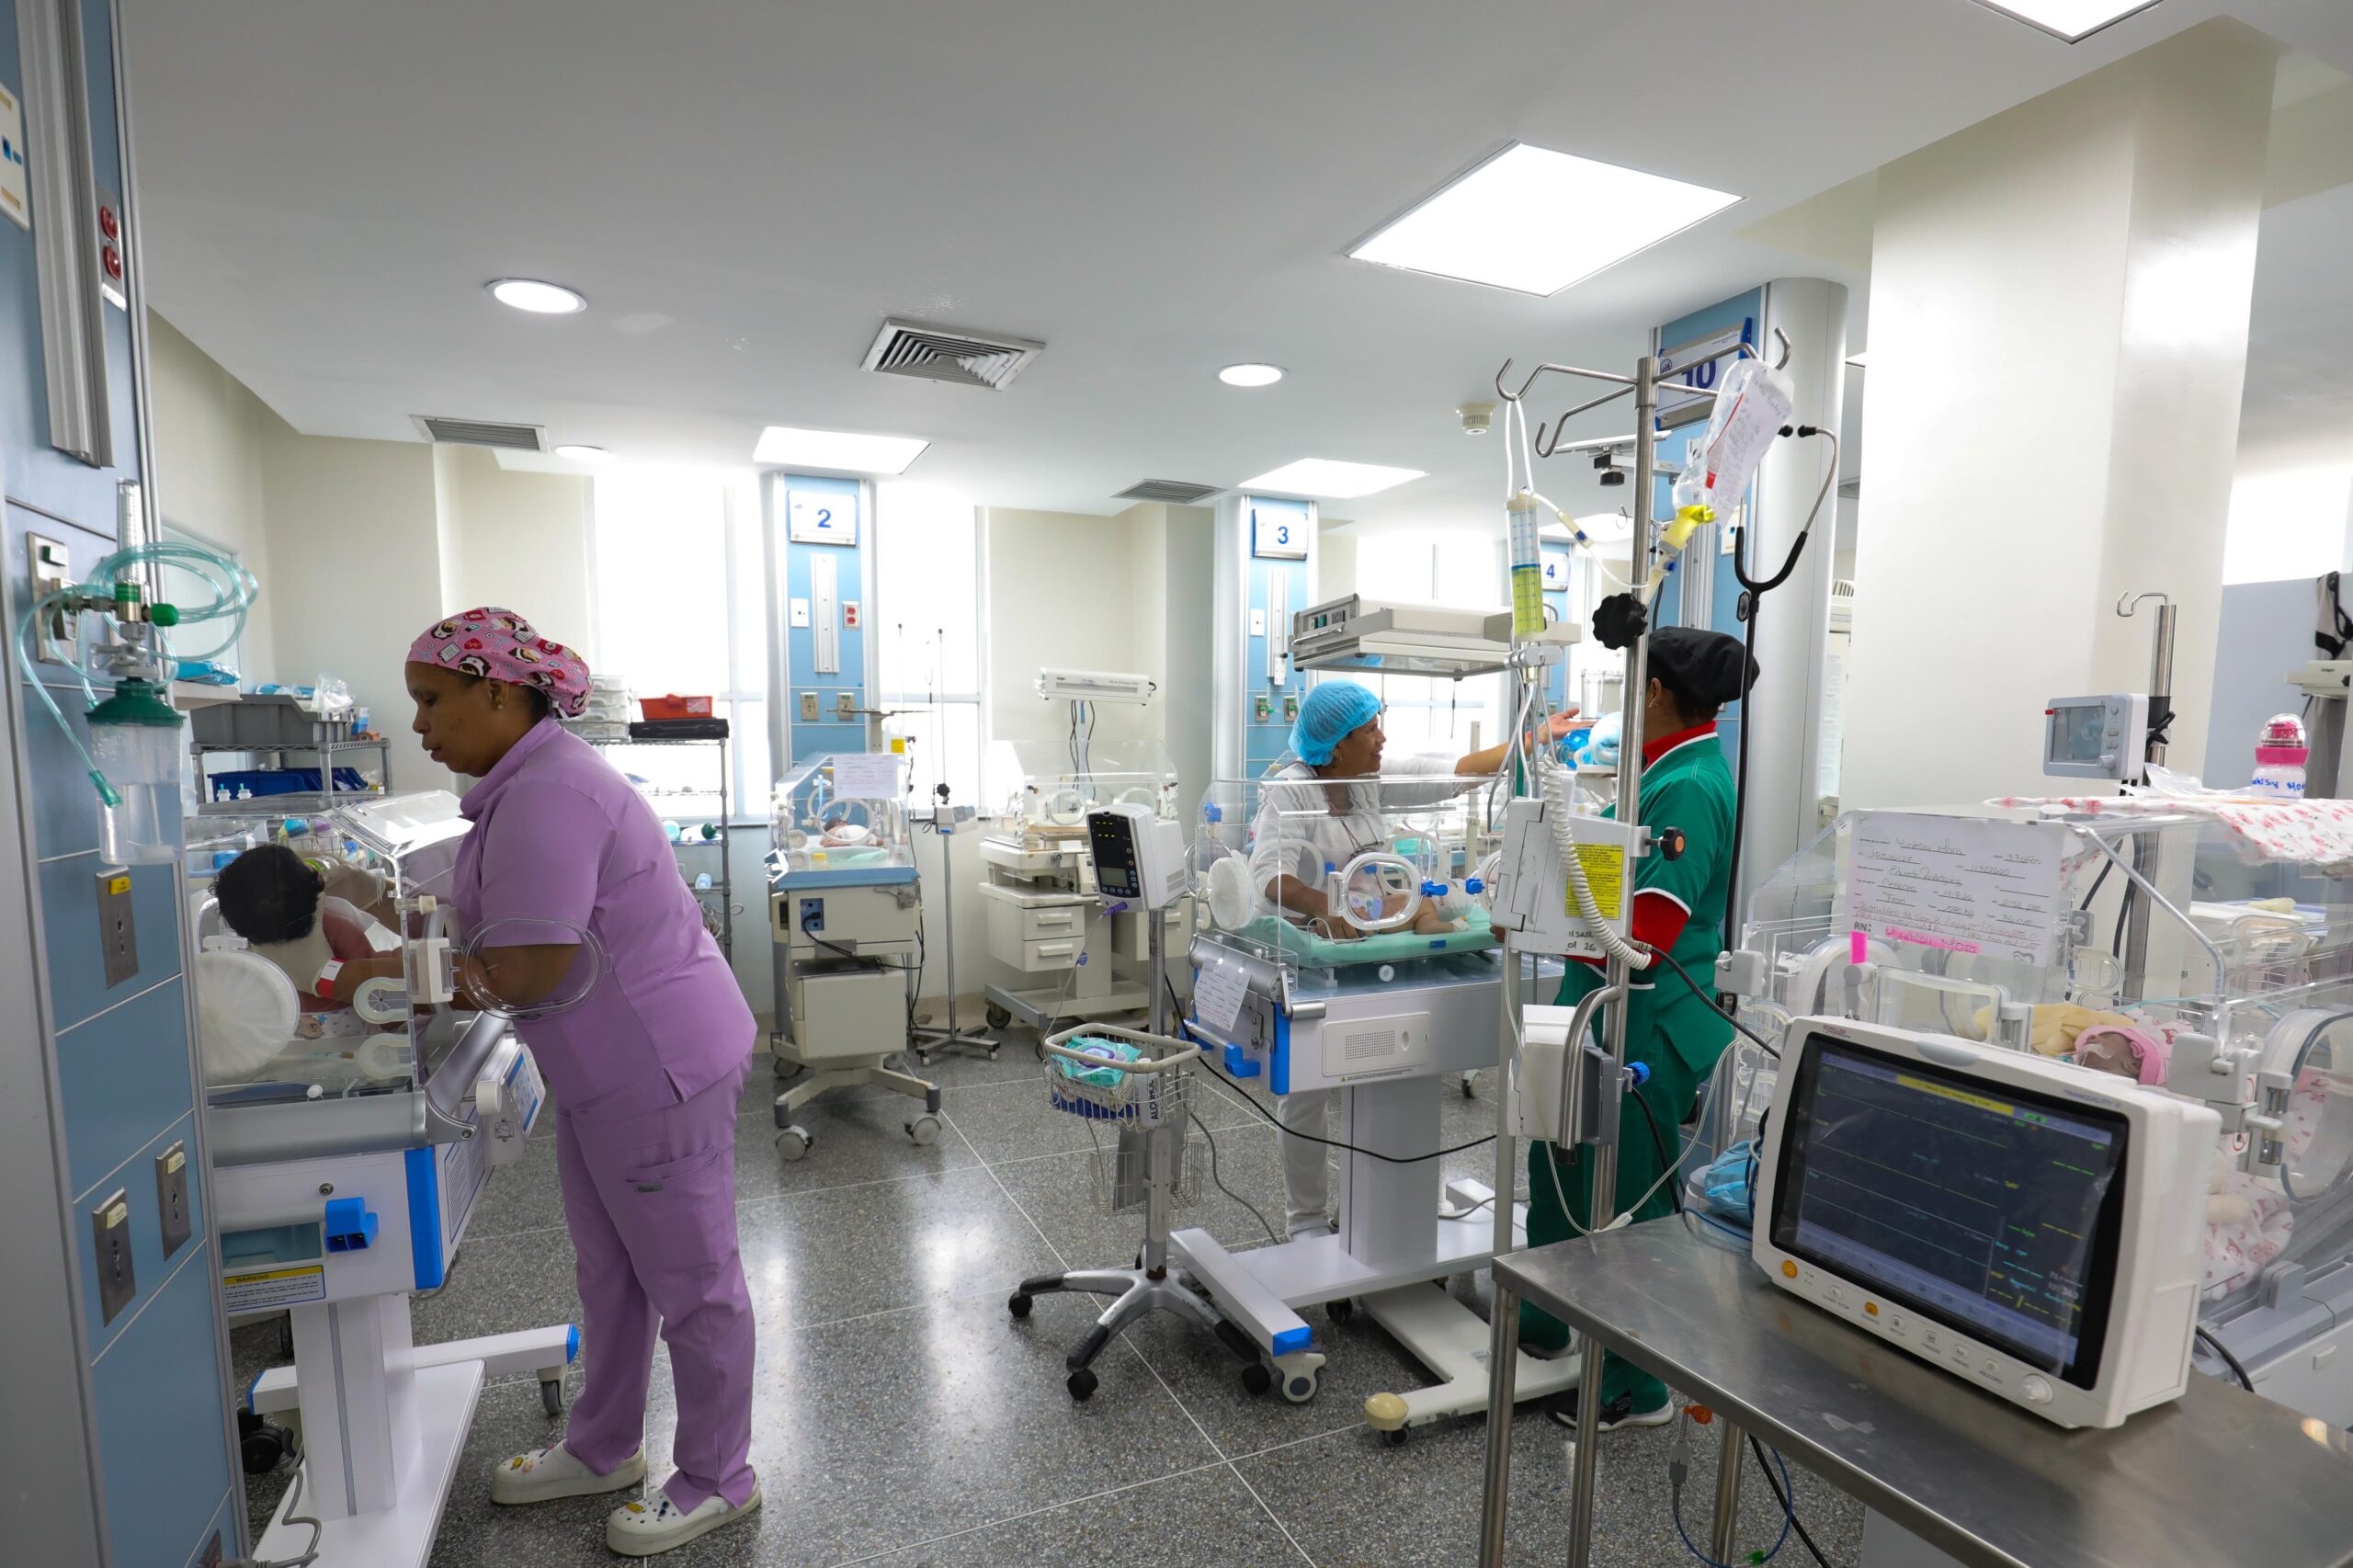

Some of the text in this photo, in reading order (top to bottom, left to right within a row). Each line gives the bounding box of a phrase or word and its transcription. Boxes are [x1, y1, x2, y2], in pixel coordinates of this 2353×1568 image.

[1680, 358, 1717, 390] 10
[817, 508, 832, 528] 2
[1278, 526, 1289, 545] 3
[1546, 563, 1555, 579] 4
[1854, 922, 1871, 932] RN:
[1149, 1079, 1159, 1120] ALCOHOL
[235, 1274, 270, 1283] WARNING
